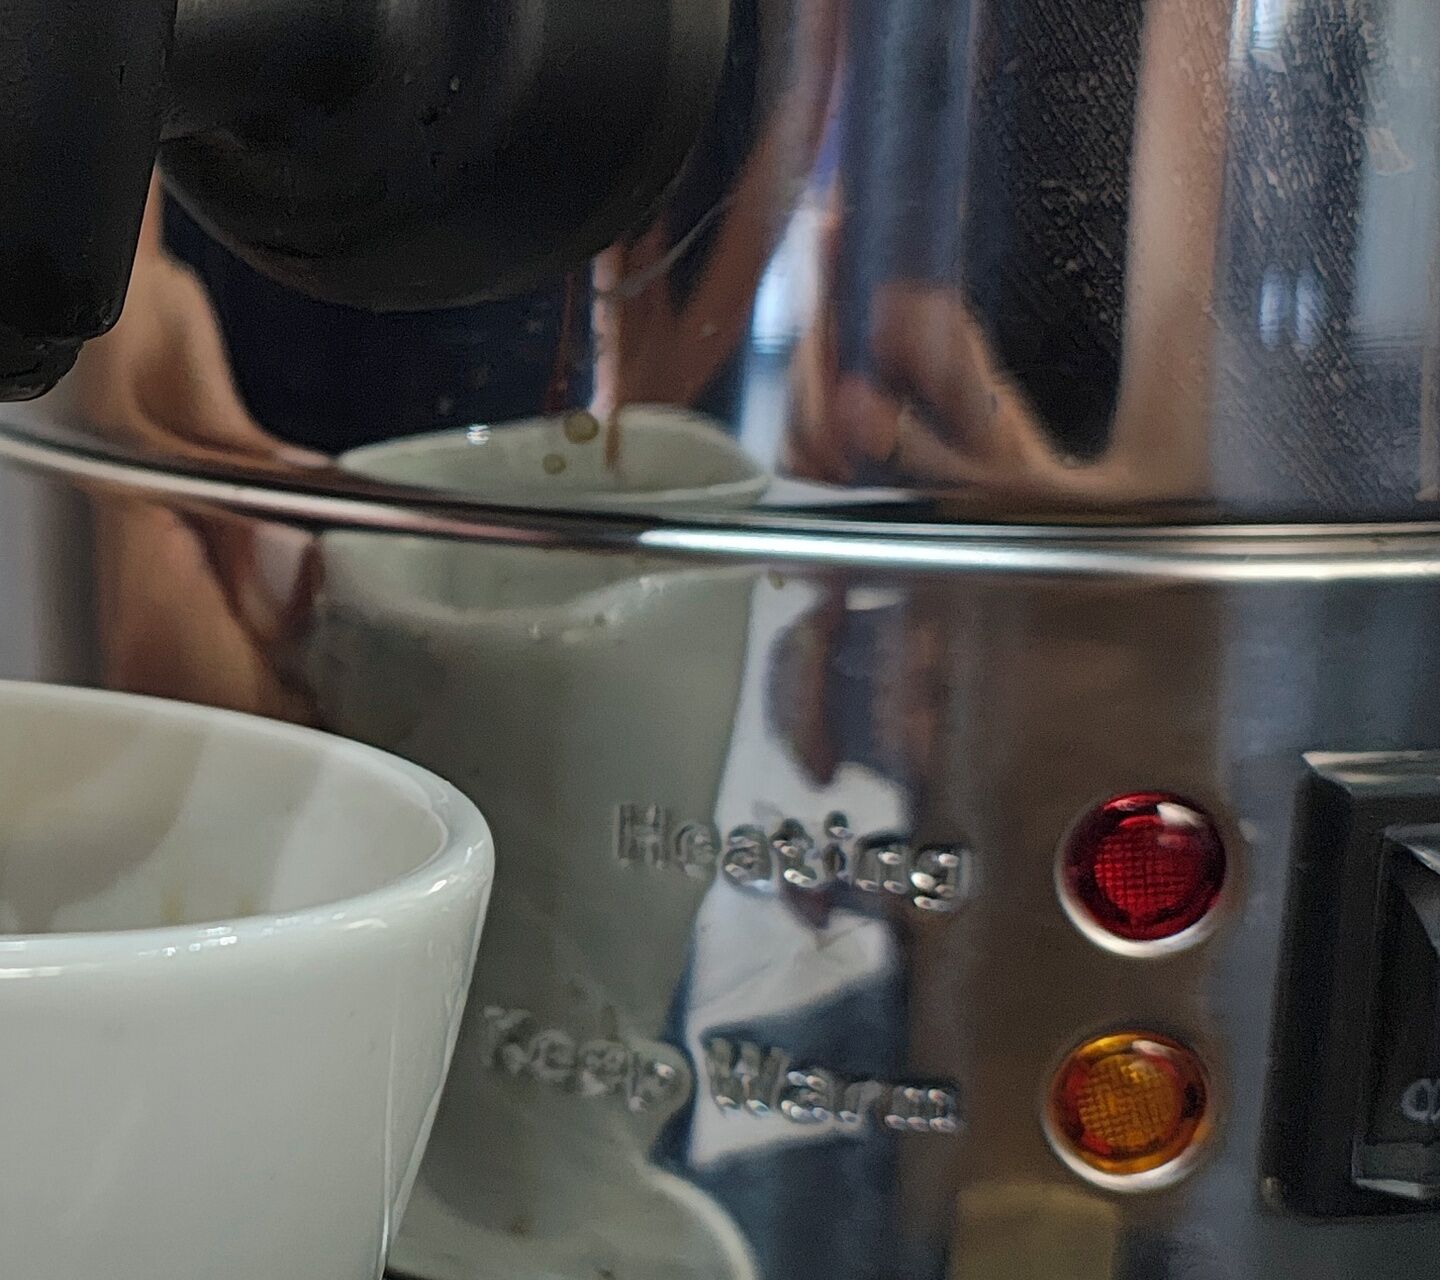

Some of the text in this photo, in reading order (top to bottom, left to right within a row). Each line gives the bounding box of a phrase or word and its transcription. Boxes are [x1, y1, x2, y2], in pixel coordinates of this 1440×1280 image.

[615, 802, 970, 912] Heating
[480, 1003, 963, 1133] Keep Warm
